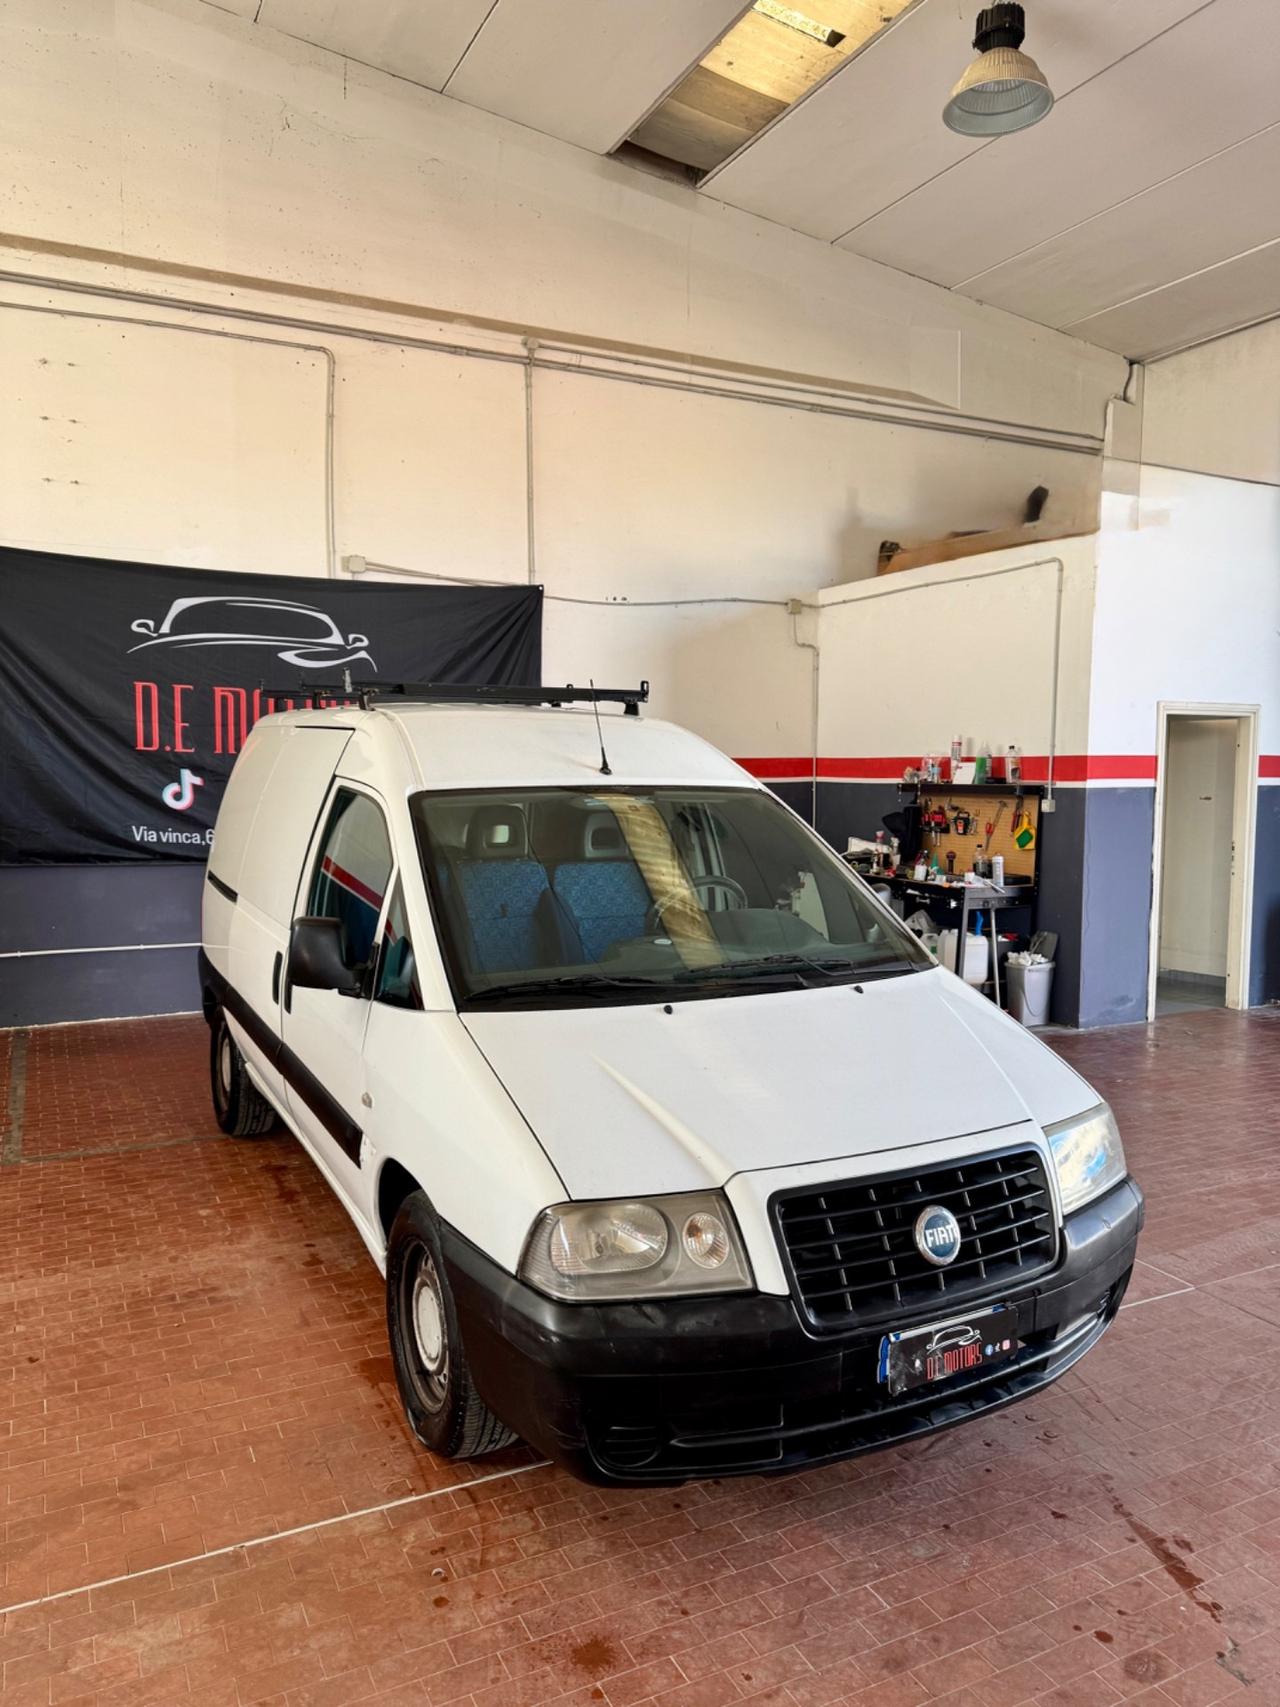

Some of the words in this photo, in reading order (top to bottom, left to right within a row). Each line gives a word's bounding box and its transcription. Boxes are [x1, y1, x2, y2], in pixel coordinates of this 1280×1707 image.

[134, 681, 195, 753] D.E
[132, 825, 157, 842] Via
[925, 1224, 954, 1248] FIAT
[943, 1342, 983, 1374] MOTORS
